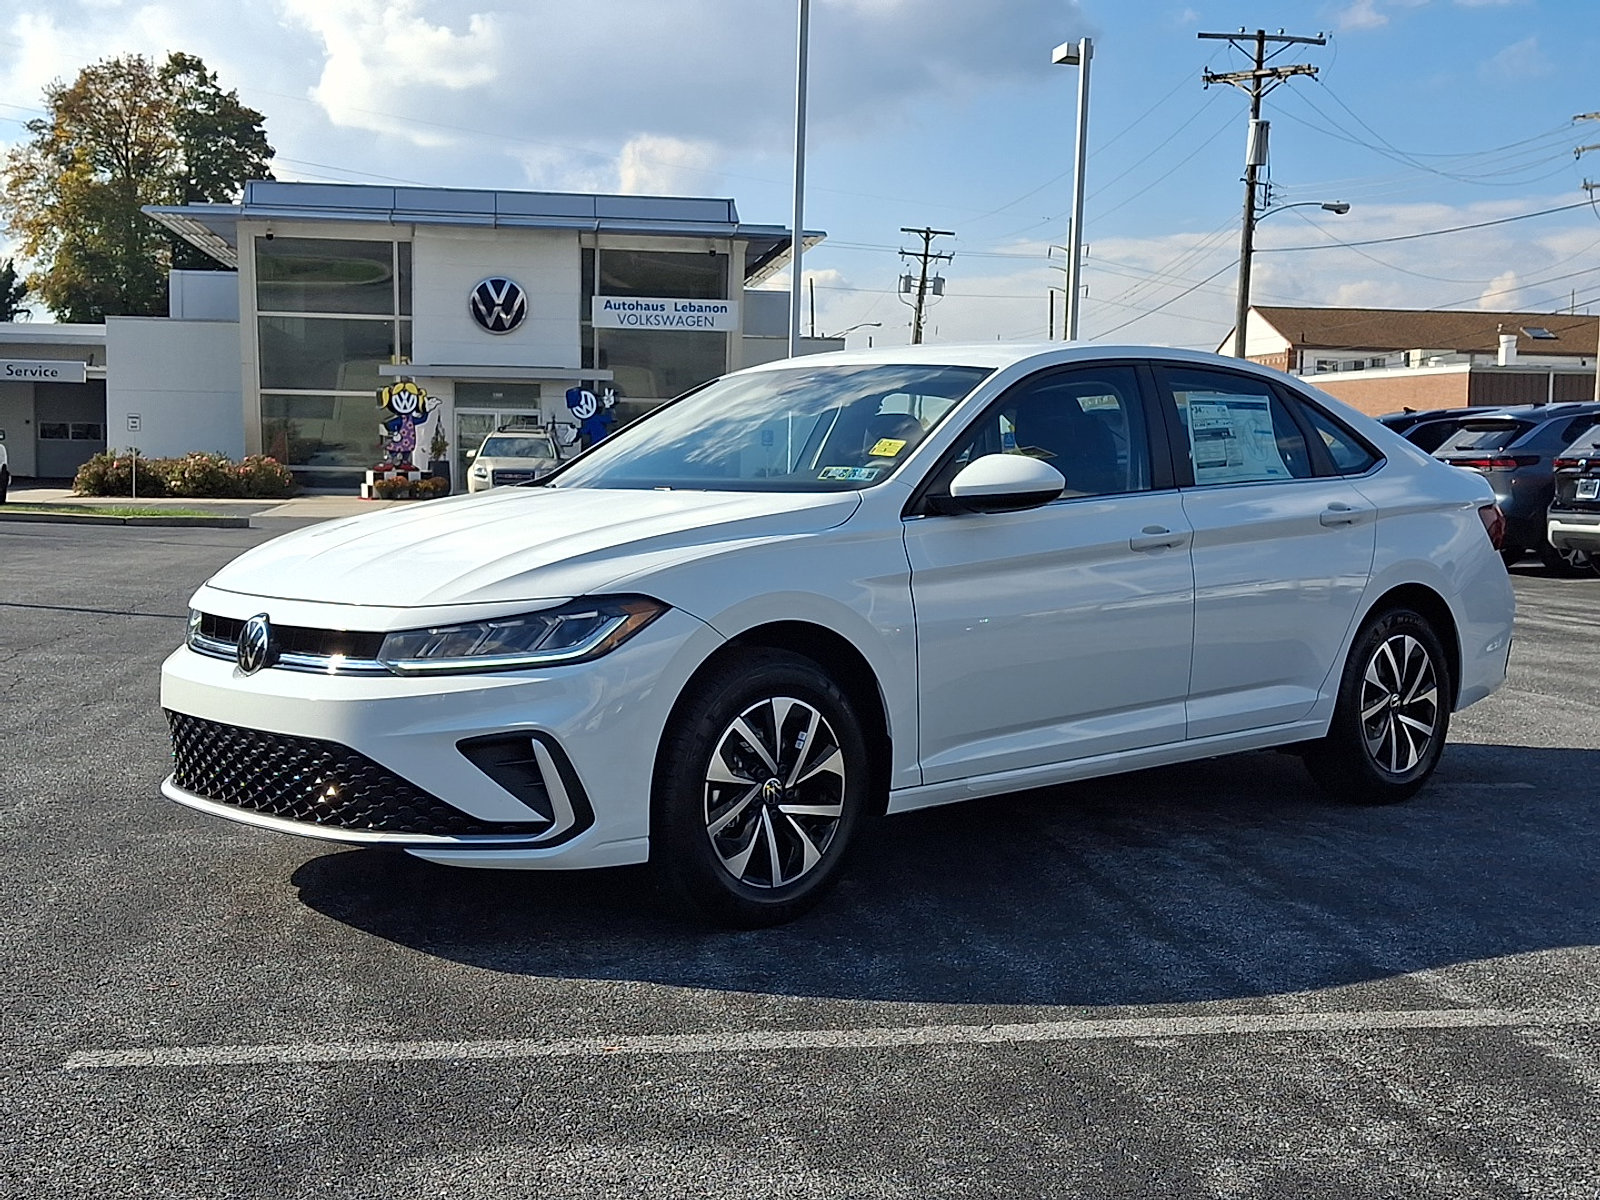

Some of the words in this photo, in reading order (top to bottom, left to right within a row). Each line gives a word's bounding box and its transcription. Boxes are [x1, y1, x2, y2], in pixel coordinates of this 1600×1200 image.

[604, 299, 666, 312] Autohaus
[674, 302, 728, 314] Lebanon
[617, 314, 716, 328] VOLKSWAGEN
[6, 364, 58, 377] Service
